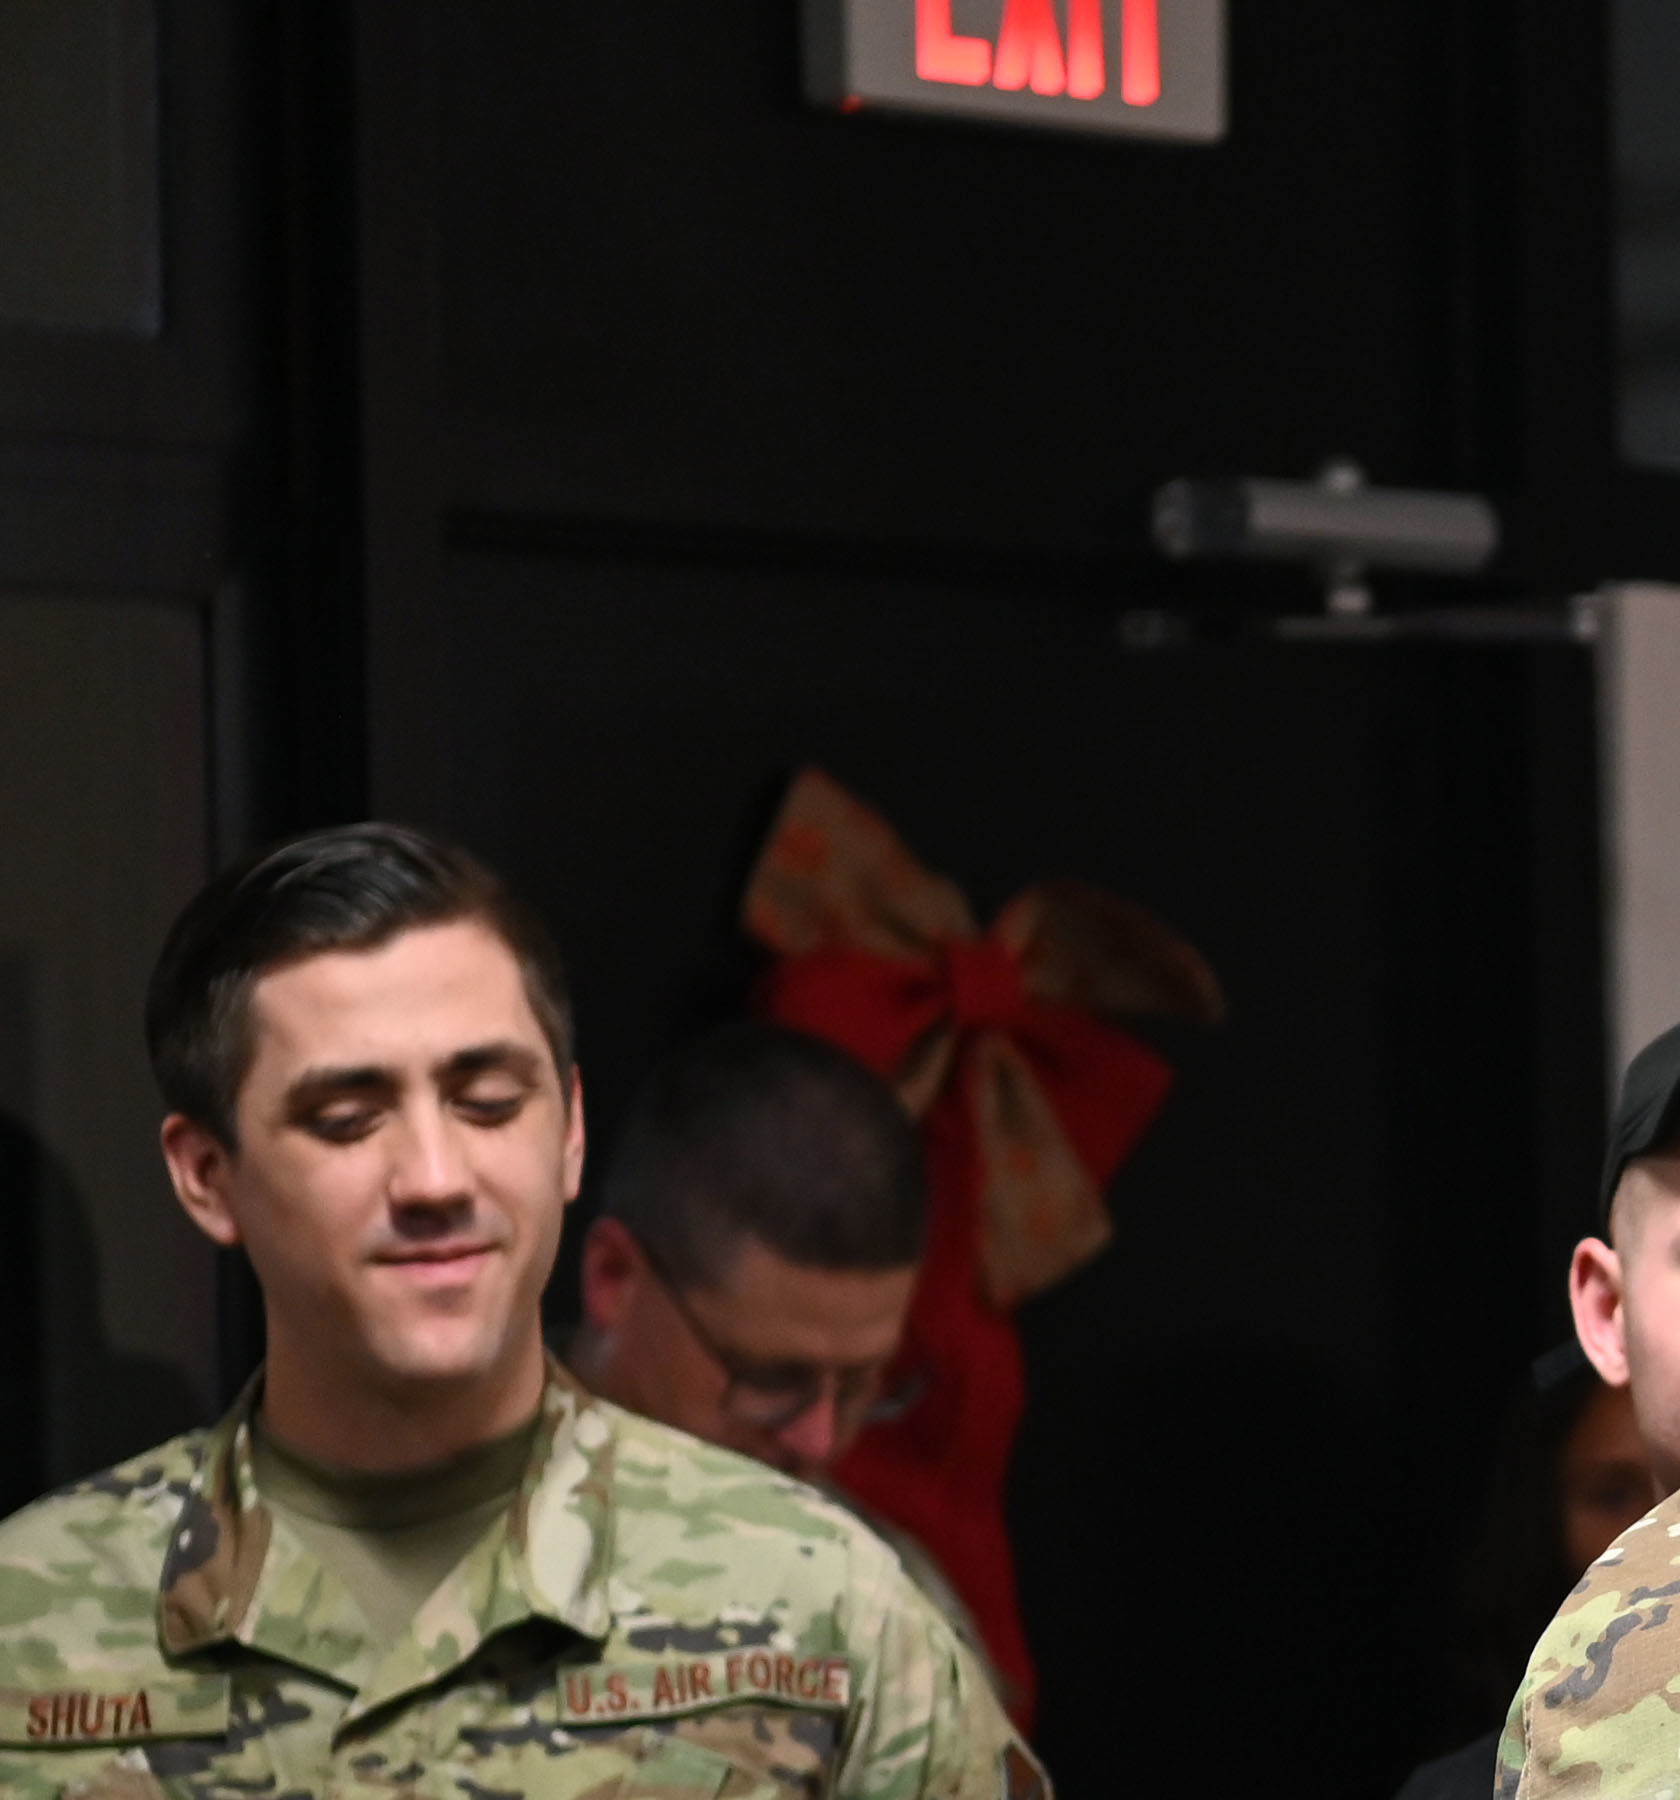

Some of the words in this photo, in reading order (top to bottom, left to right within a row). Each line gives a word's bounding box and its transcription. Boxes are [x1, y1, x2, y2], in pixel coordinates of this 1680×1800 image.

[565, 1672, 640, 1714] U.S.
[653, 1659, 713, 1705] AIR
[727, 1651, 848, 1701] FORCE
[26, 1688, 151, 1738] SHUTA
